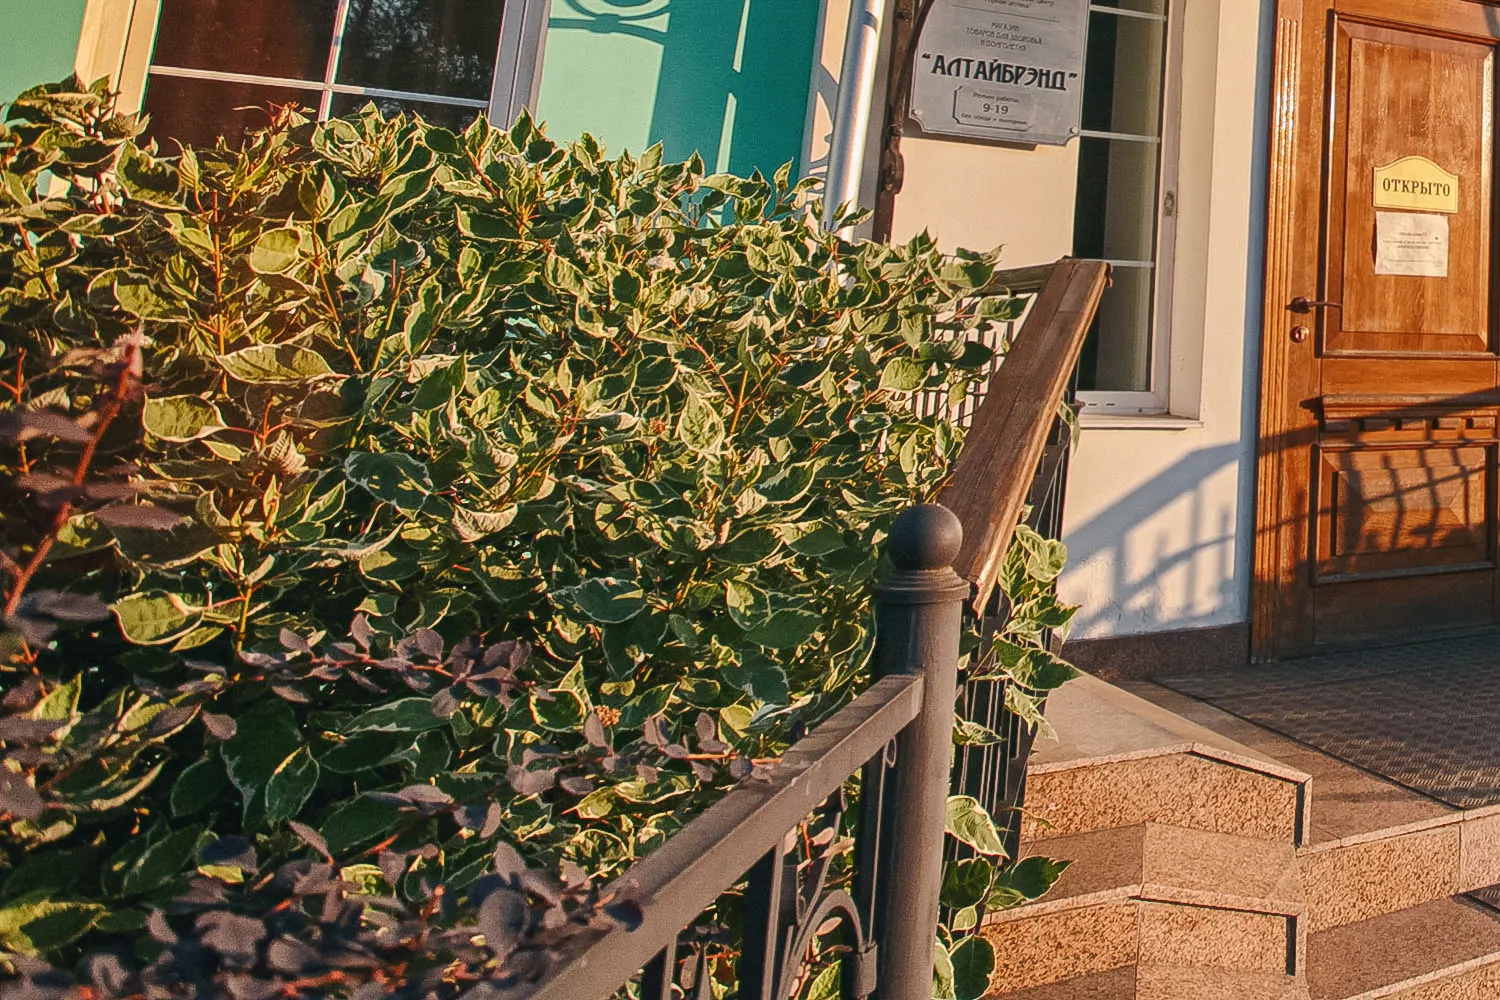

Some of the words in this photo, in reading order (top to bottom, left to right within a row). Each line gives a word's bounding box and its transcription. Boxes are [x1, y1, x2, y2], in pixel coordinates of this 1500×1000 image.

[966, 26, 995, 38] ТОВАРОВ
[983, 102, 1009, 115] 9-19
[1382, 177, 1451, 197] ОТКРЫТО
